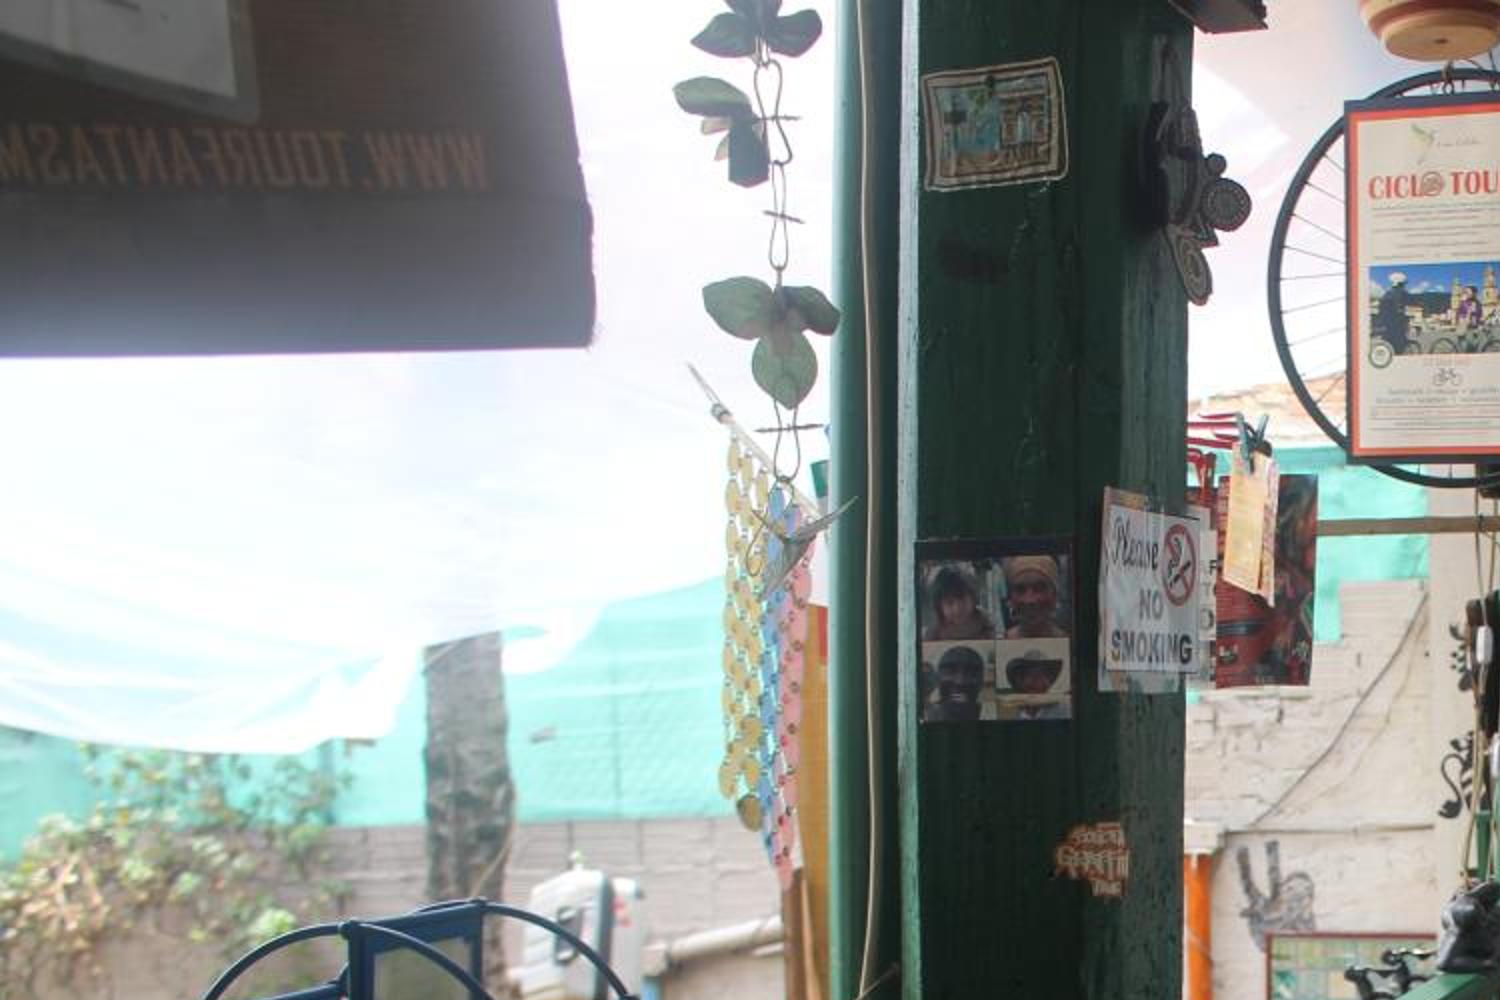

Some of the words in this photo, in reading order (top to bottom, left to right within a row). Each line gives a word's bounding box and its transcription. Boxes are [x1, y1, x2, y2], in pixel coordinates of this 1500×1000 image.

[1367, 171, 1445, 200] CICLO
[1111, 514, 1160, 571] Please
[1139, 588, 1164, 620] NO
[1111, 629, 1193, 665] SMOKING
